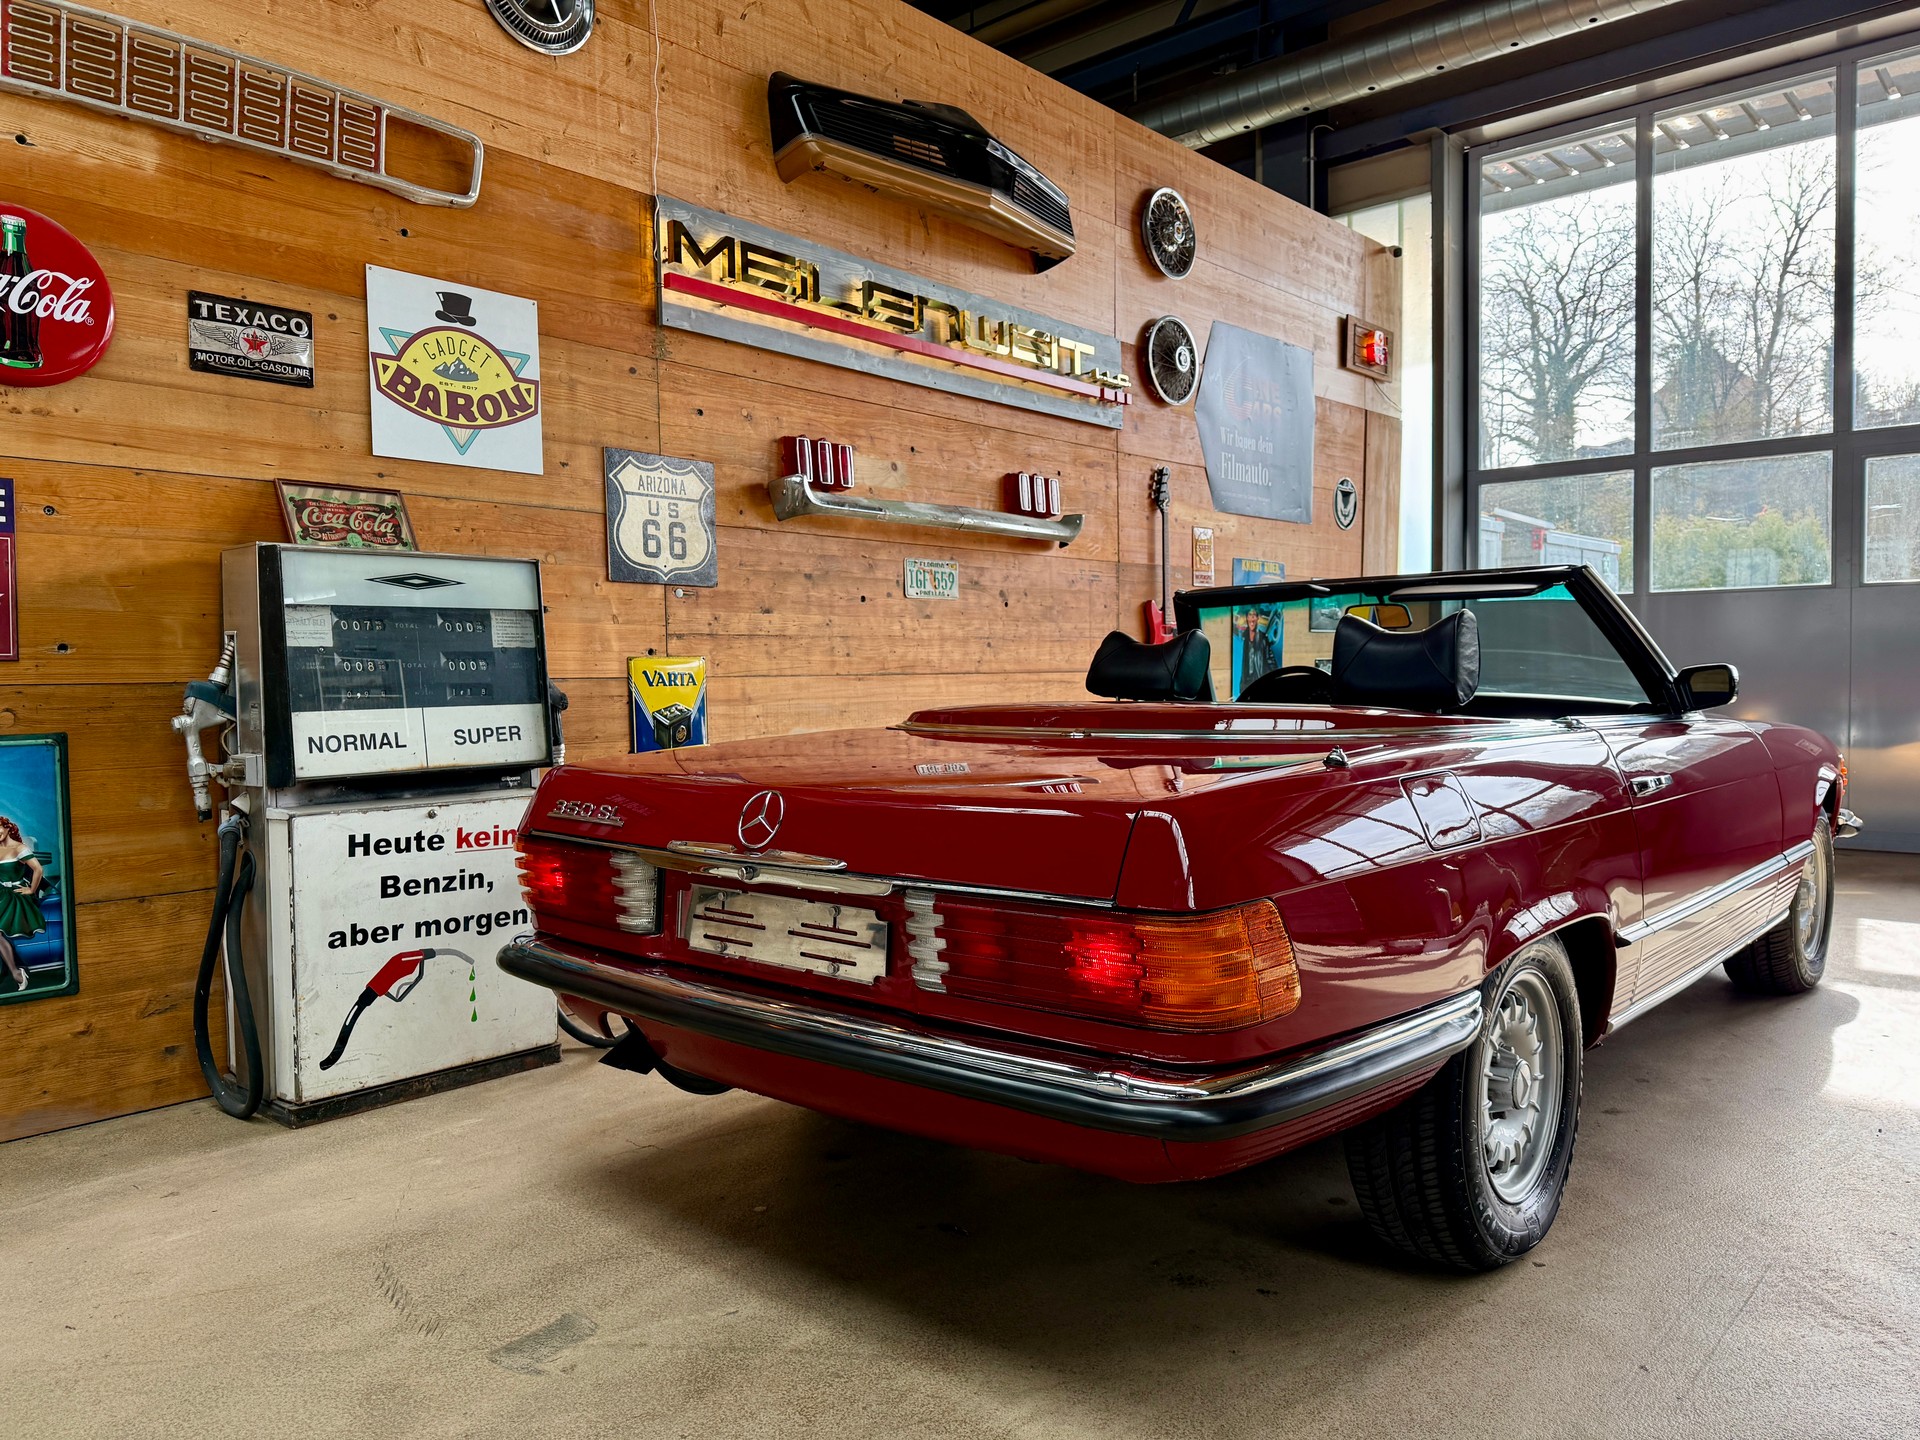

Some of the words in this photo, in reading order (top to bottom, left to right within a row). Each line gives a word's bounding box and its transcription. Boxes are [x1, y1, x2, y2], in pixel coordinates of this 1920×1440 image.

[195, 299, 310, 337] TEXACO
[422, 336, 492, 369] GADGET
[261, 361, 312, 378] GASOLINE
[382, 363, 533, 423] BARON
[1220, 427, 1234, 446] Wir
[1257, 434, 1273, 454] dein
[1221, 452, 1272, 486] Filmauto.
[638, 475, 687, 495] ARIZONA
[302, 506, 395, 533] Coca-Cola
[648, 500, 679, 518] US
[642, 519, 687, 560] 66
[642, 670, 698, 687] VARTA
[308, 732, 407, 754] NORMAL
[453, 725, 522, 746] SUPER
[552, 799, 596, 818] 350
[597, 804, 621, 822] SL
[348, 830, 445, 858] Heute
[380, 869, 494, 899] Benzin,
[327, 923, 404, 950] aber
